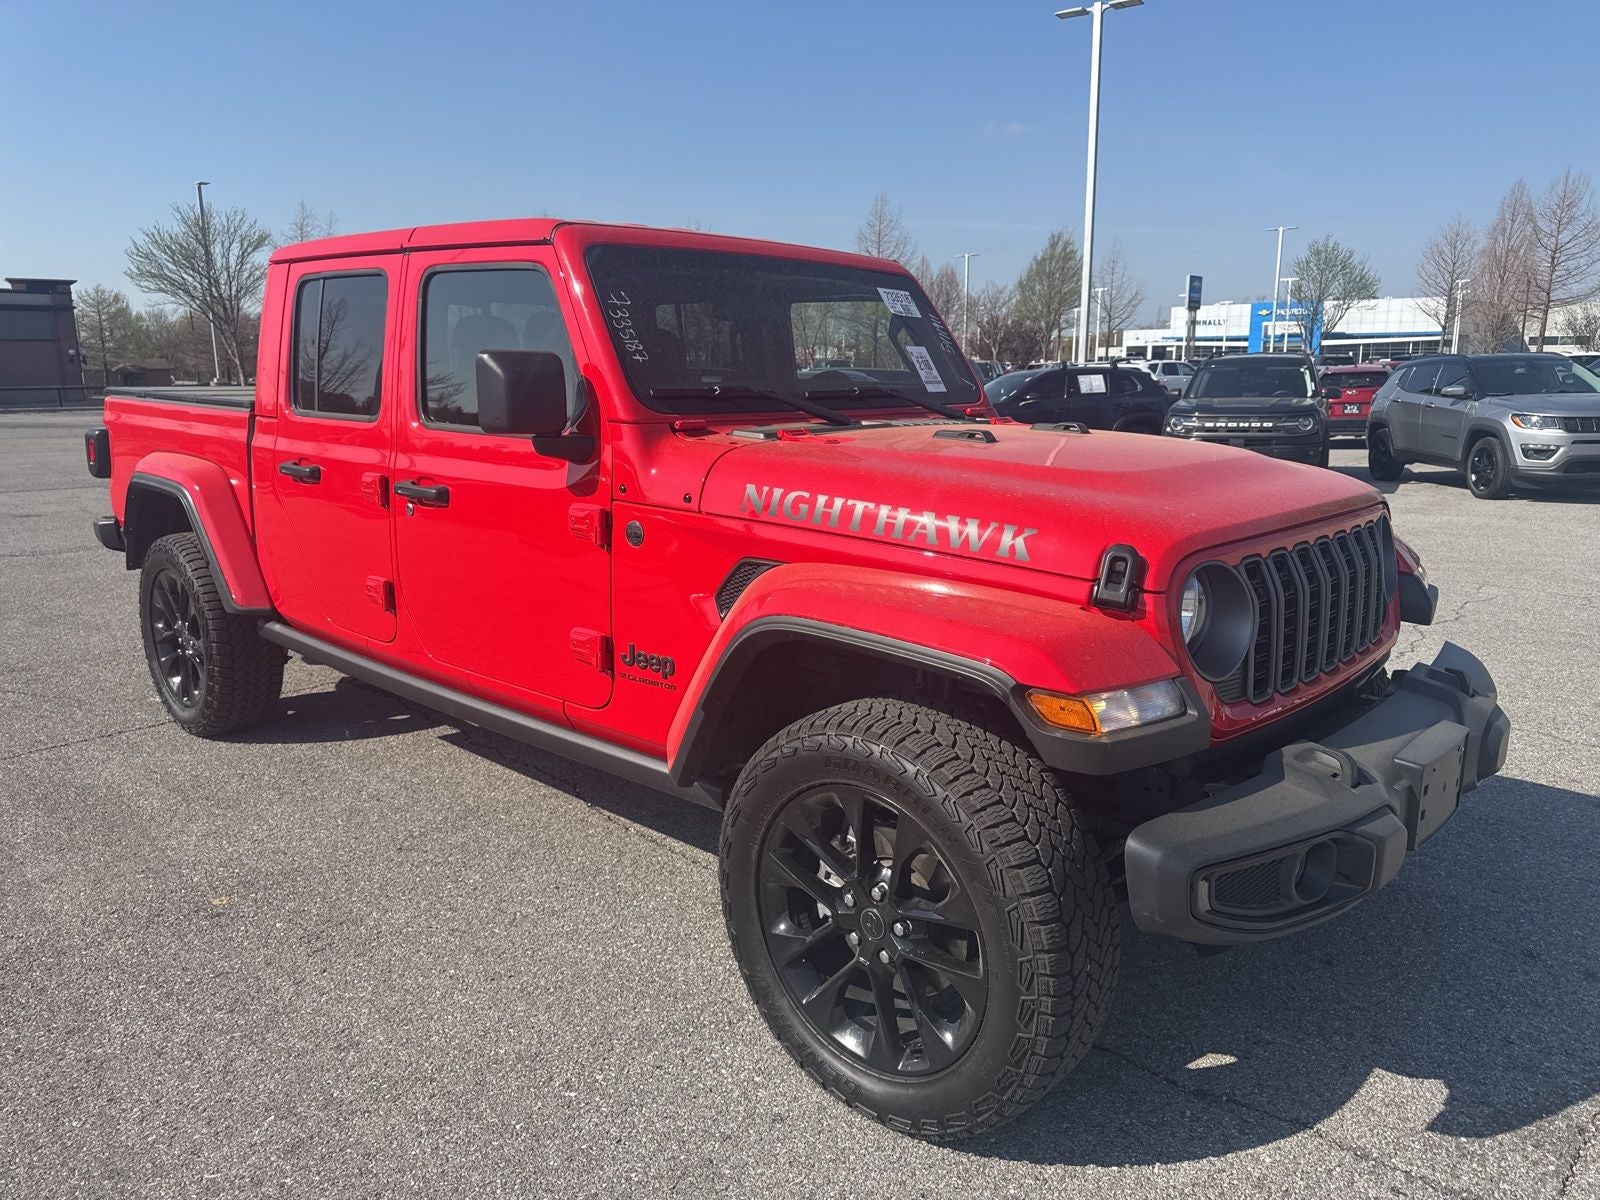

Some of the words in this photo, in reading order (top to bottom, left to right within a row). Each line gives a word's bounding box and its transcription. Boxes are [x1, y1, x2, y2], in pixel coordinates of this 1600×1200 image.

[607, 290, 649, 363] 7335187
[740, 483, 1038, 562] NIGHTHAWK
[621, 643, 676, 680] Jeep
[627, 674, 677, 691] GLADIATOR
